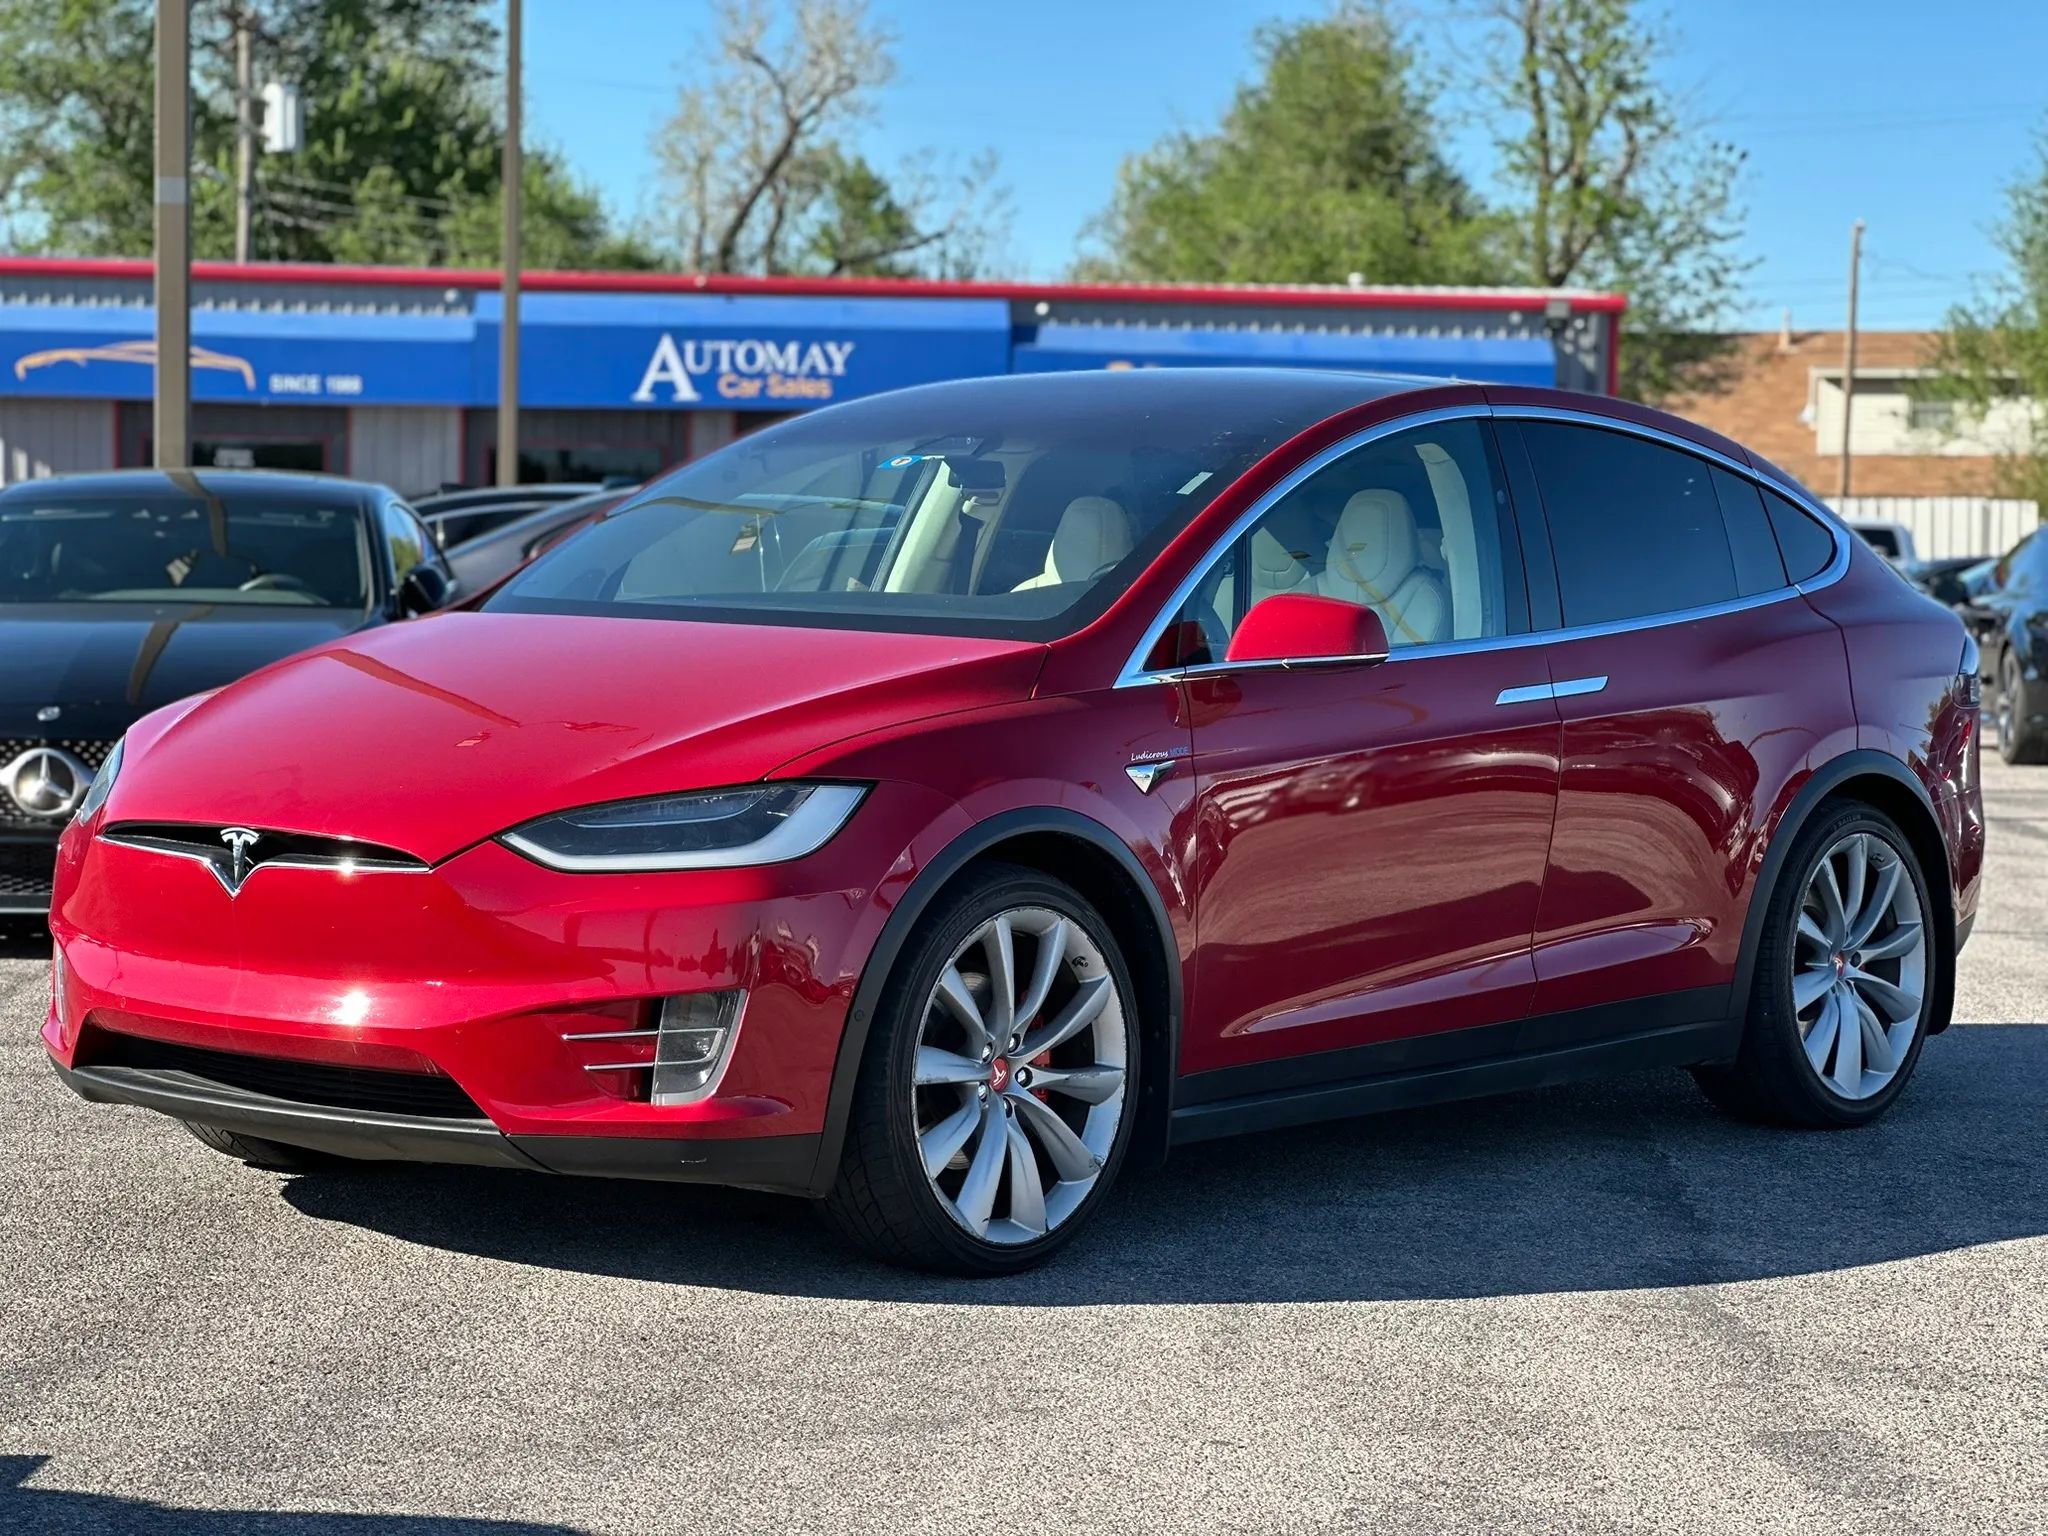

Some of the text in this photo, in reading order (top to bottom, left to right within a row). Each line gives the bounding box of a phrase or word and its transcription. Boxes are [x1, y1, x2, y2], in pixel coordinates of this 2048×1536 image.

[632, 332, 853, 402] AUTOMAY
[270, 374, 320, 393] SINCE
[718, 374, 832, 398] Car Sales
[1131, 751, 1168, 761] Ludicrous
